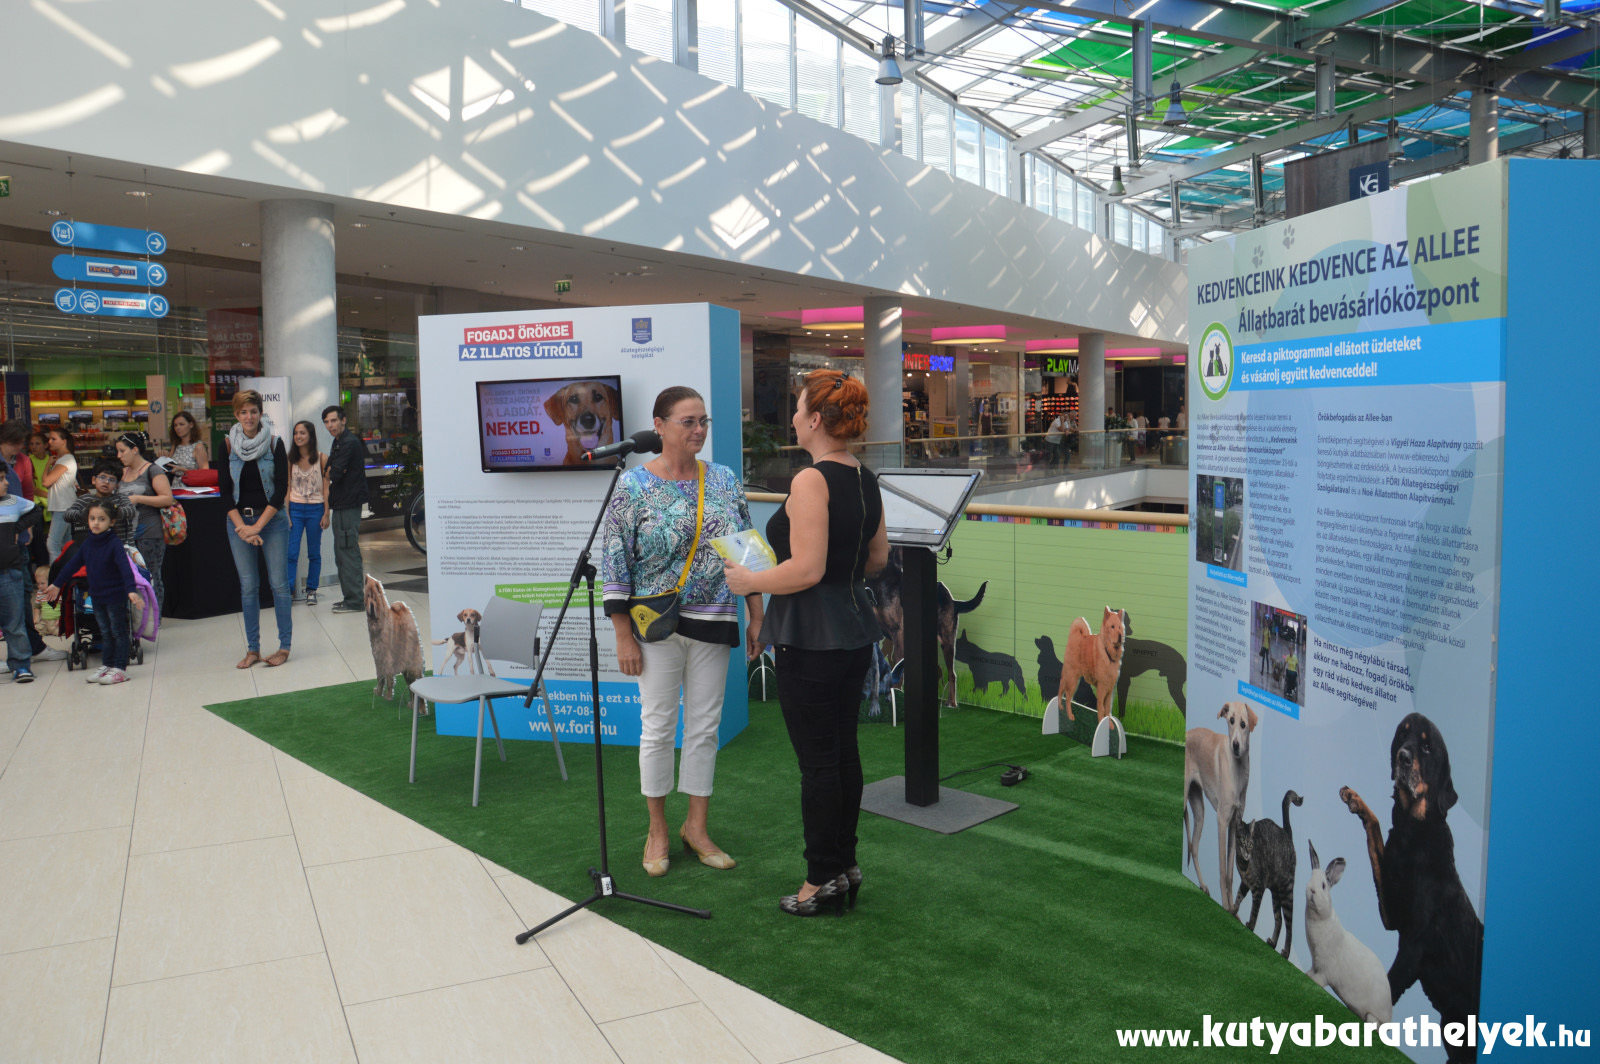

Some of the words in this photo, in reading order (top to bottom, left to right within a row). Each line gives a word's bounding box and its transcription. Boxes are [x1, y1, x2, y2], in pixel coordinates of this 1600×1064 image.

[1197, 267, 1285, 305] KEDVENCEINK
[1290, 247, 1377, 288] KEDVENCE
[1382, 240, 1408, 270] AZ
[1414, 225, 1480, 265] ALLEE
[1238, 302, 1305, 332] Állatbarát
[1310, 276, 1480, 322] bevásárlóközpont
[467, 328, 515, 343] FOGADJ
[518, 324, 569, 339] ÖRÖKBE
[461, 347, 477, 359] AZ
[481, 346, 531, 358] ILLATOS
[534, 343, 578, 358] ÚTRÓL!
[1241, 349, 1266, 364] Keresd
[1267, 352, 1272, 362] a
[1273, 342, 1333, 366] piktogrammal
[1334, 340, 1369, 356] ellátott
[1371, 336, 1421, 353] üzleteket
[904, 353, 954, 372] INTERSPORT
[1241, 371, 1249, 383] és
[1250, 367, 1280, 385] vásárolj
[1281, 367, 1308, 384] együtt
[1309, 362, 1377, 378] kedvenceddel!
[262, 393, 280, 402] UNK!
[486, 409, 493, 418] A
[496, 404, 542, 417] LABDÁT.
[1318, 412, 1357, 424] Örökbefogadás
[1365, 412, 1392, 422] Allee-ban
[485, 420, 544, 436] NEKED.
[1391, 437, 1409, 450] Vigyél
[1410, 438, 1425, 448] Haza
[1426, 439, 1461, 452] Alapítvány
[1313, 636, 1322, 647] Ha
[1323, 639, 1338, 653] nincs
[1339, 644, 1353, 660] még
[1354, 649, 1385, 671] négylábú
[1386, 659, 1410, 679] társad,
[1313, 650, 1330, 665] akkor
[1331, 659, 1338, 668] ne
[1340, 659, 1364, 680] habozz,
[1365, 667, 1387, 688] fogadj
[1389, 675, 1414, 694] örökbe
[1313, 667, 1323, 679] egy
[1324, 668, 1334, 681] rád
[1336, 672, 1349, 686] váró
[1351, 678, 1373, 695] kedves
[1375, 686, 1397, 703] állatot
[580, 691, 603, 703] híva
[607, 695, 622, 703] ezt
[632, 695, 641, 704] te
[1313, 681, 1319, 689] az
[1320, 681, 1335, 695] Allee
[1336, 687, 1377, 714] segítségével!
[554, 705, 607, 717] 347-08-0
[529, 720, 617, 736] www.forihu
